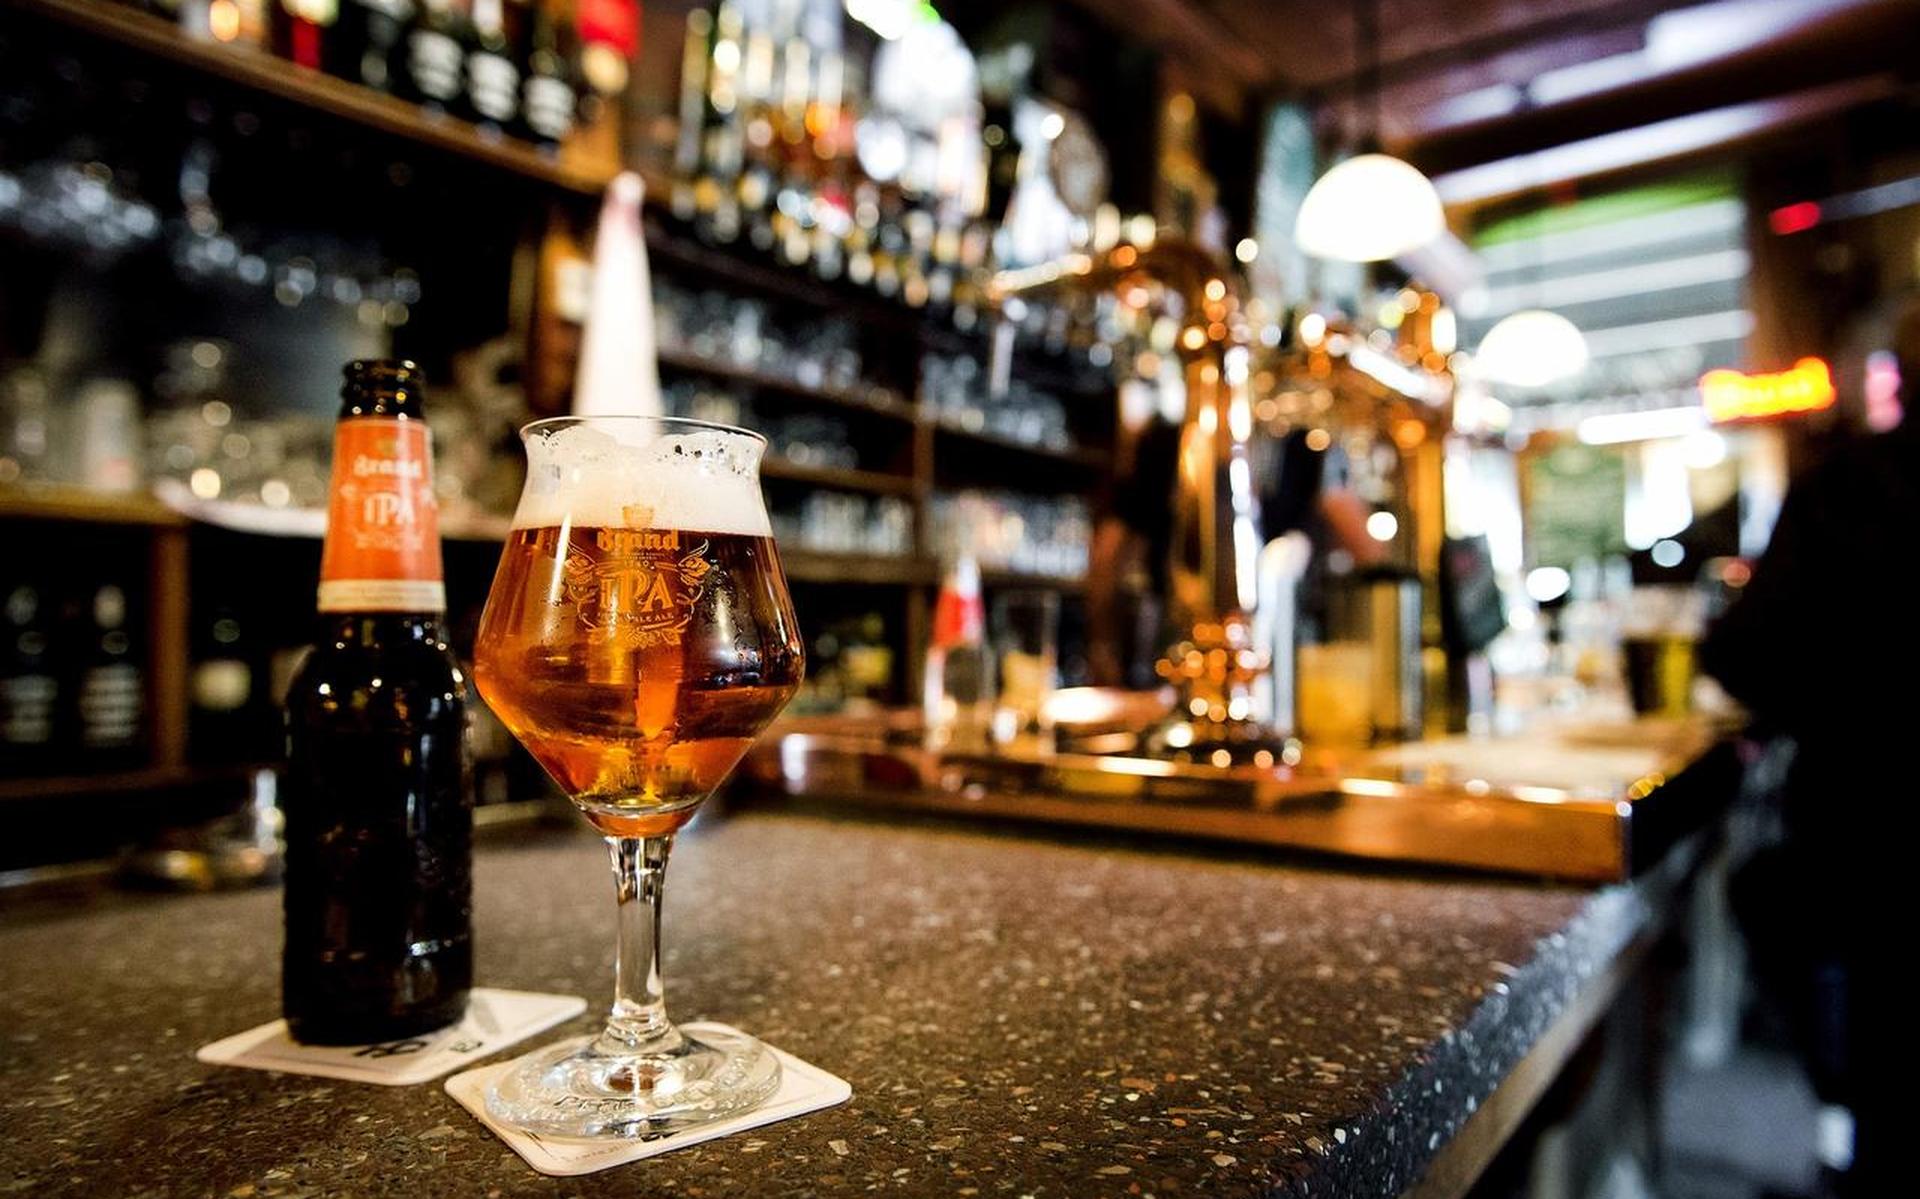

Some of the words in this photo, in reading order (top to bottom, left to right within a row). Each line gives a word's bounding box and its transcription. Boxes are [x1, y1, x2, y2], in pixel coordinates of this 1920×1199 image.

[363, 492, 414, 525] IPA
[597, 527, 680, 551] Brand
[600, 569, 674, 613] IPA
